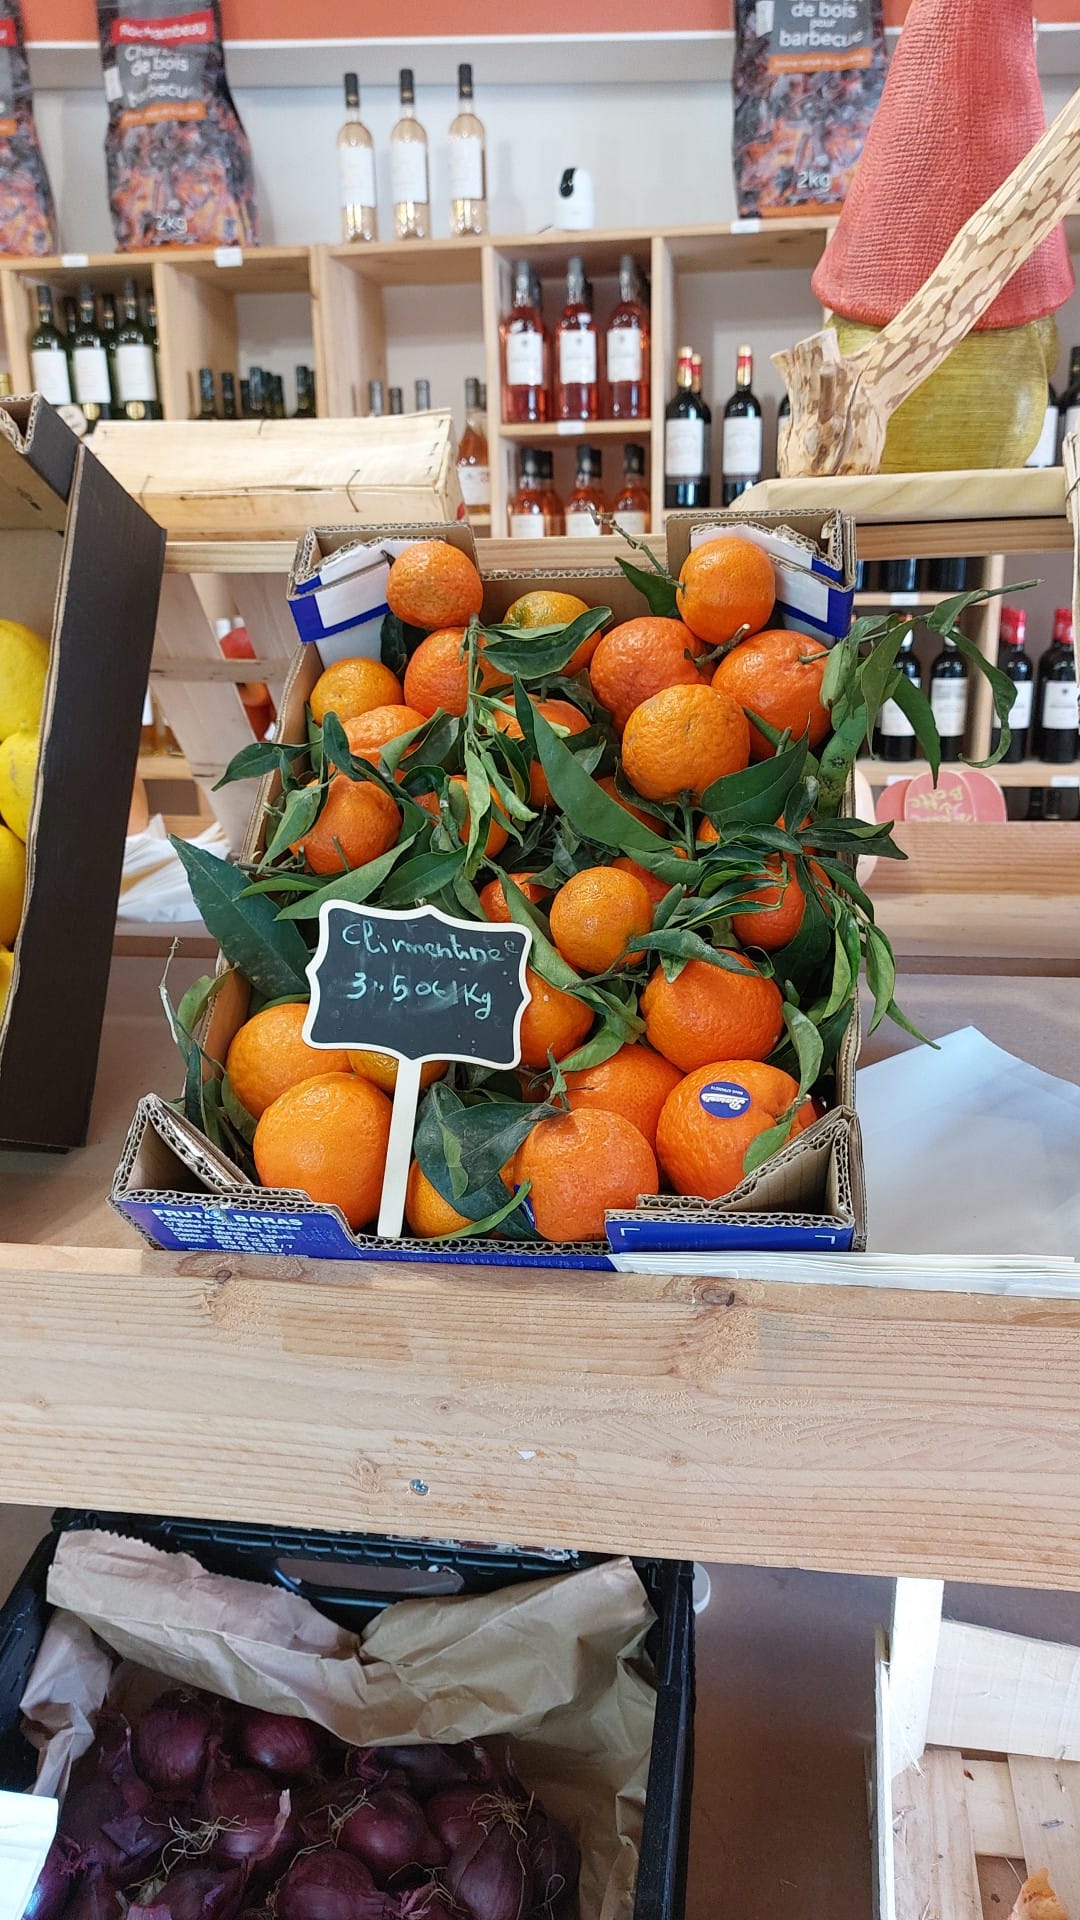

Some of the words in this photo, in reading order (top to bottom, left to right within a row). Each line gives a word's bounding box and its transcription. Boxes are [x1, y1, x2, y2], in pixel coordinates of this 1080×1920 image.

[791, 1, 815, 17] de
[819, 1, 857, 18] bois
[809, 19, 836, 31] pour
[780, 29, 864, 47] barbecue
[130, 60, 151, 76] de
[153, 57, 188, 71] bois
[797, 171, 832, 194] 2kg
[233, 1215, 303, 1226] BARAS
